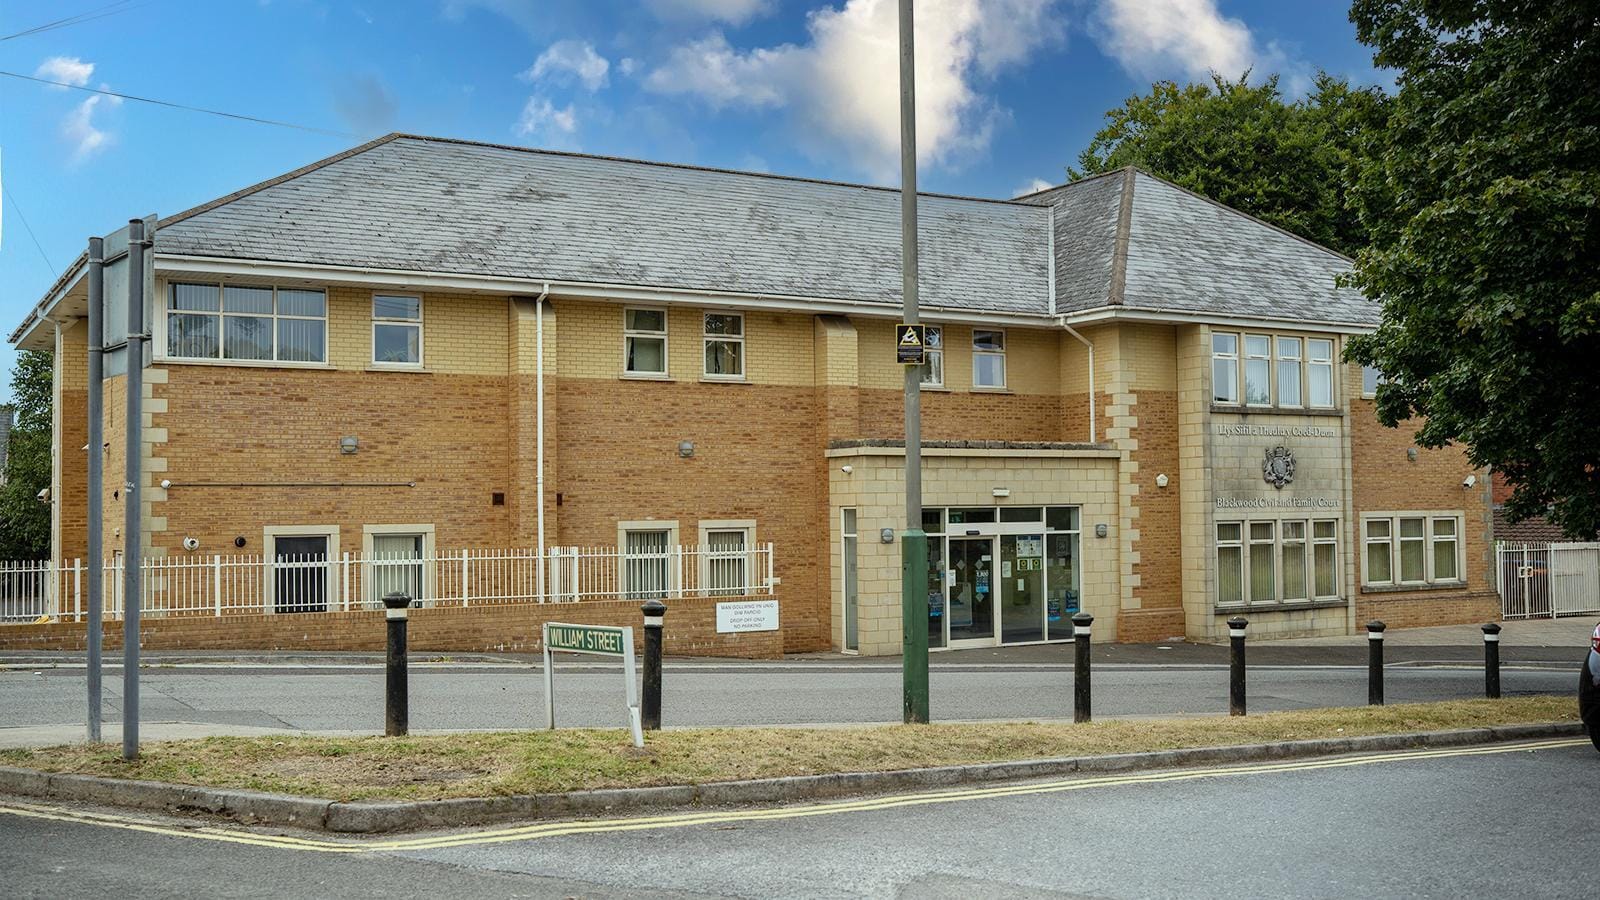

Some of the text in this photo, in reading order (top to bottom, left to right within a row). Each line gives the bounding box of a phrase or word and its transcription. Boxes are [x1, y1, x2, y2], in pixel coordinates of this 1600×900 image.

[1217, 424, 1234, 438] Llys
[1235, 424, 1251, 437] Sifil
[1216, 497, 1339, 510] Blackwood Civil and Family Court
[550, 628, 621, 651] WILLIAM STREET
